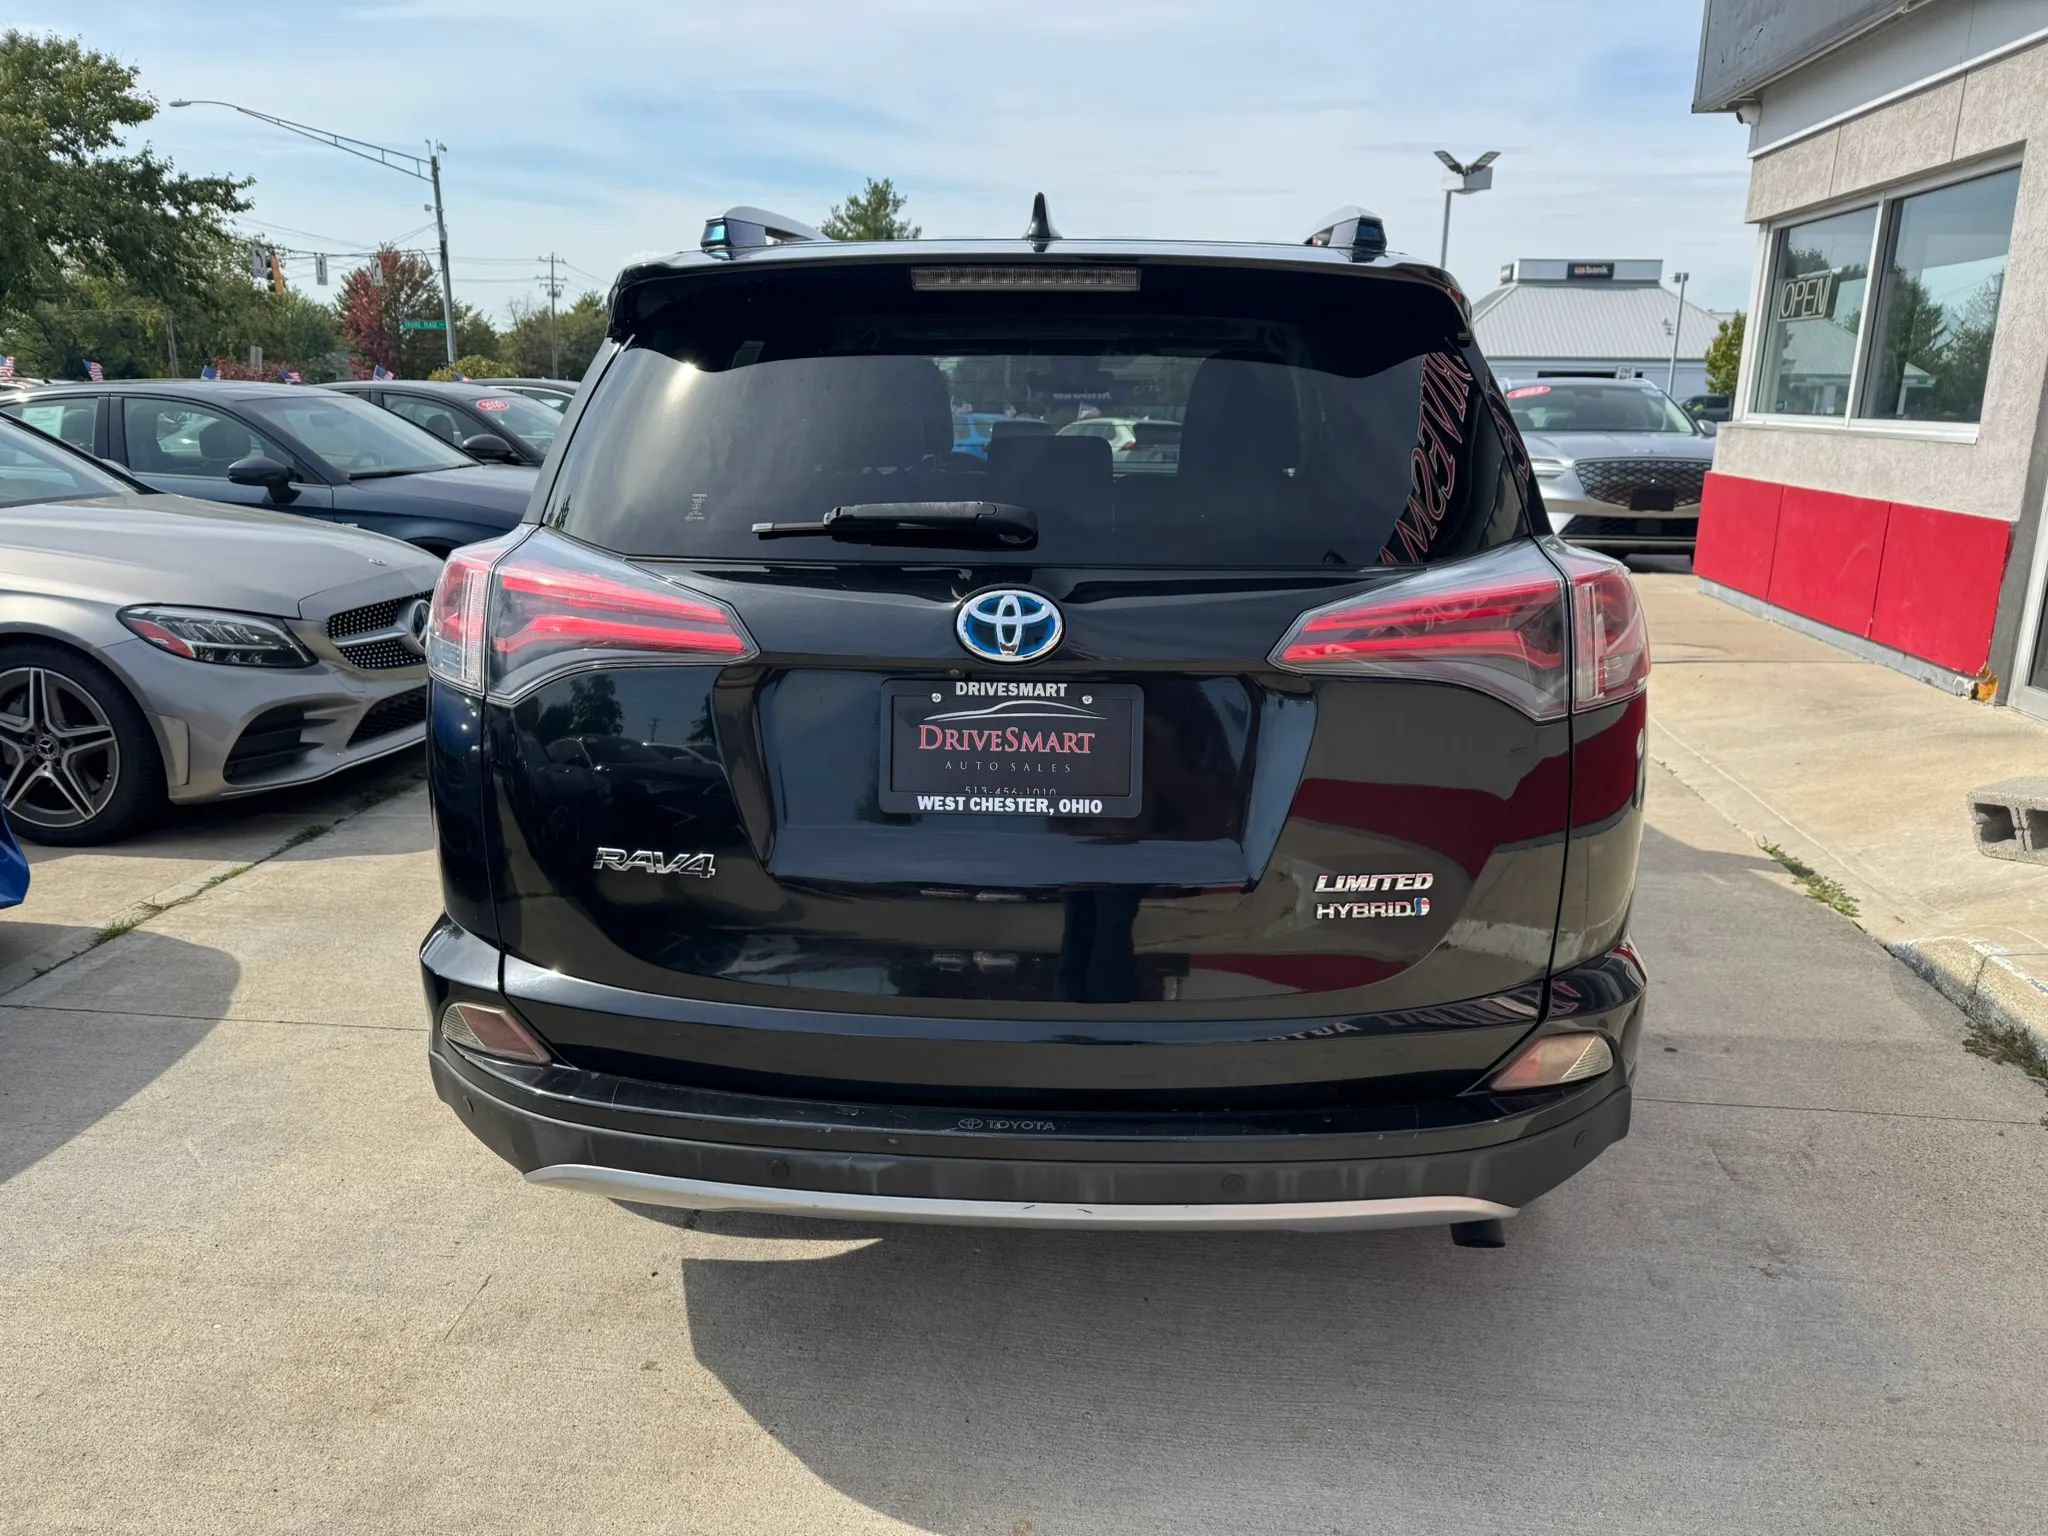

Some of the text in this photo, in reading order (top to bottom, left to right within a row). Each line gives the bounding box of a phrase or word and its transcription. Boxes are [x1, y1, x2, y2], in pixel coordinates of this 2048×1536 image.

[1782, 277, 1829, 317] OPEN
[955, 682, 1067, 697] DRIVESMART
[944, 761, 1071, 773] AUTO SALES
[917, 796, 1103, 816] WEST CHESTER, OHIO
[593, 847, 716, 878] RAV4
[1315, 873, 1434, 892] LIMITED
[1316, 901, 1412, 919] HYBRID
[987, 1120, 1056, 1131] TOYOTA
